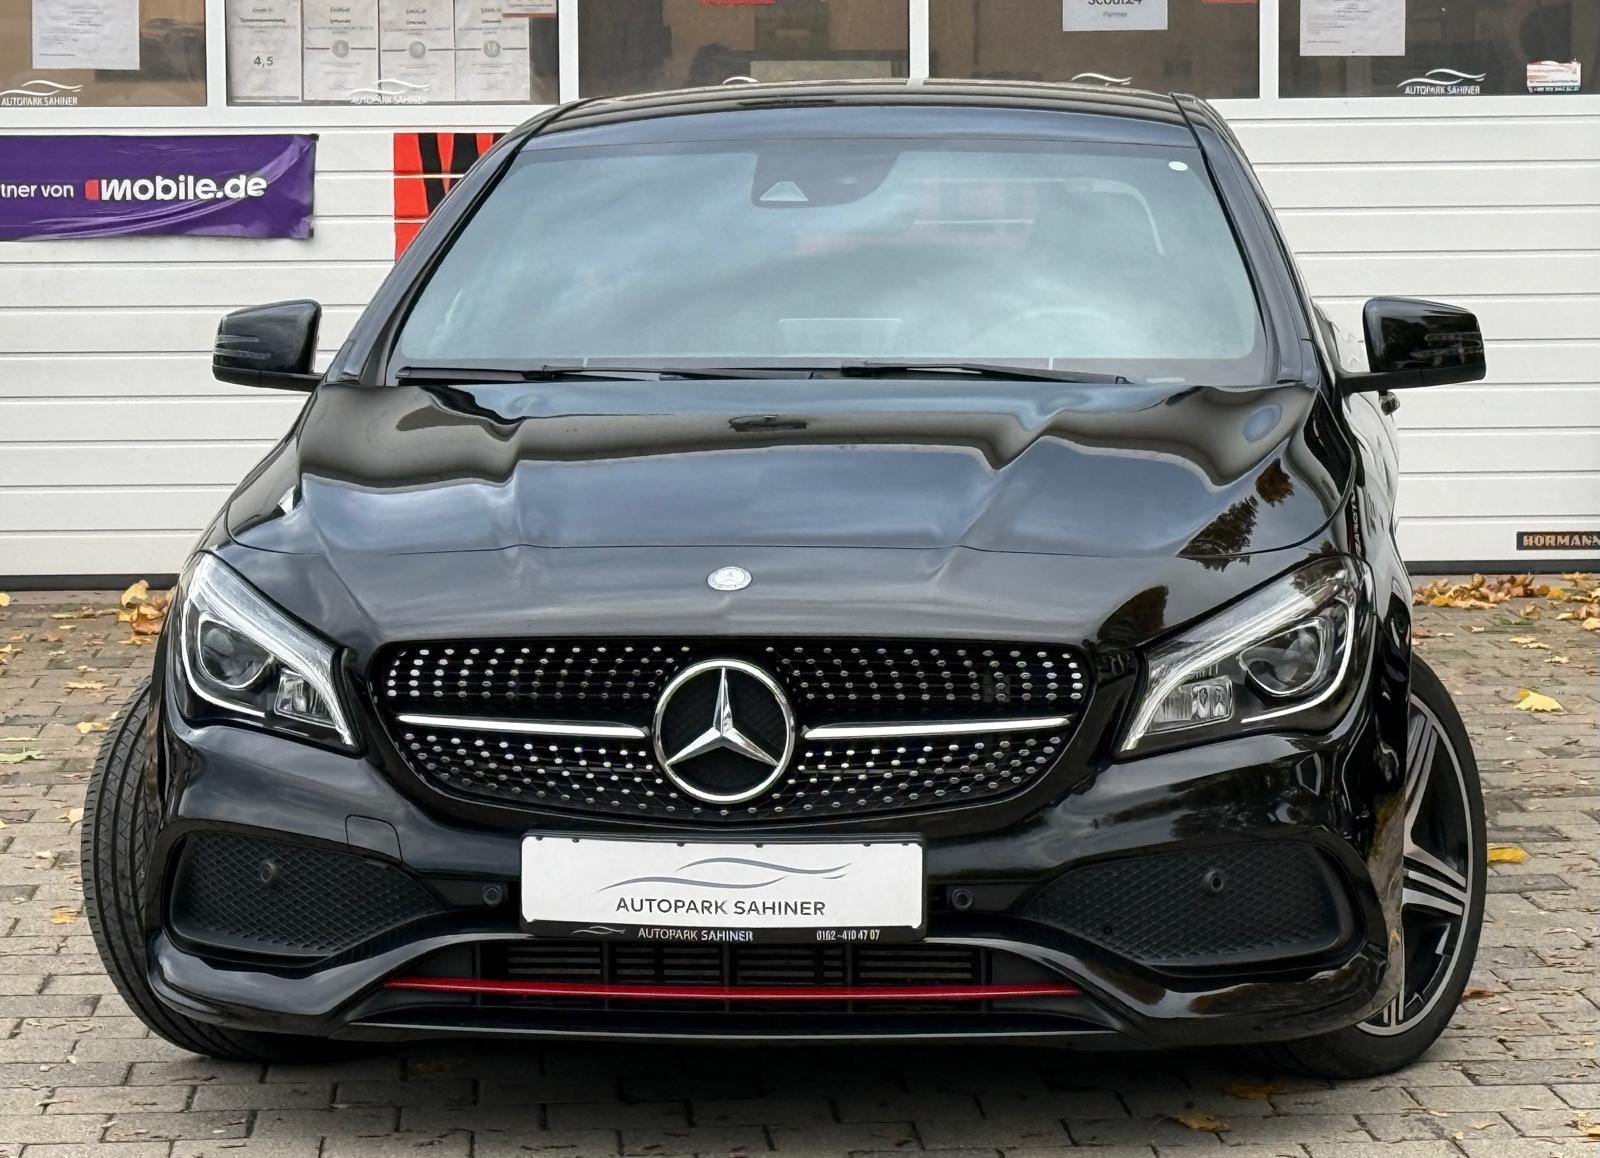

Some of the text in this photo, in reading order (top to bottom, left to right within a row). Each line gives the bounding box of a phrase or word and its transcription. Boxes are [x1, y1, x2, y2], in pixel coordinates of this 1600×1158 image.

[253, 56, 273, 68] 4,5
[1, 97, 43, 106] AUTOPARK
[0, 175, 267, 201] tner von mobile.de
[616, 897, 826, 916] AUTOPARK SAHINER
[637, 927, 698, 940] AUTOPARK
[701, 929, 754, 941] SAHINER
